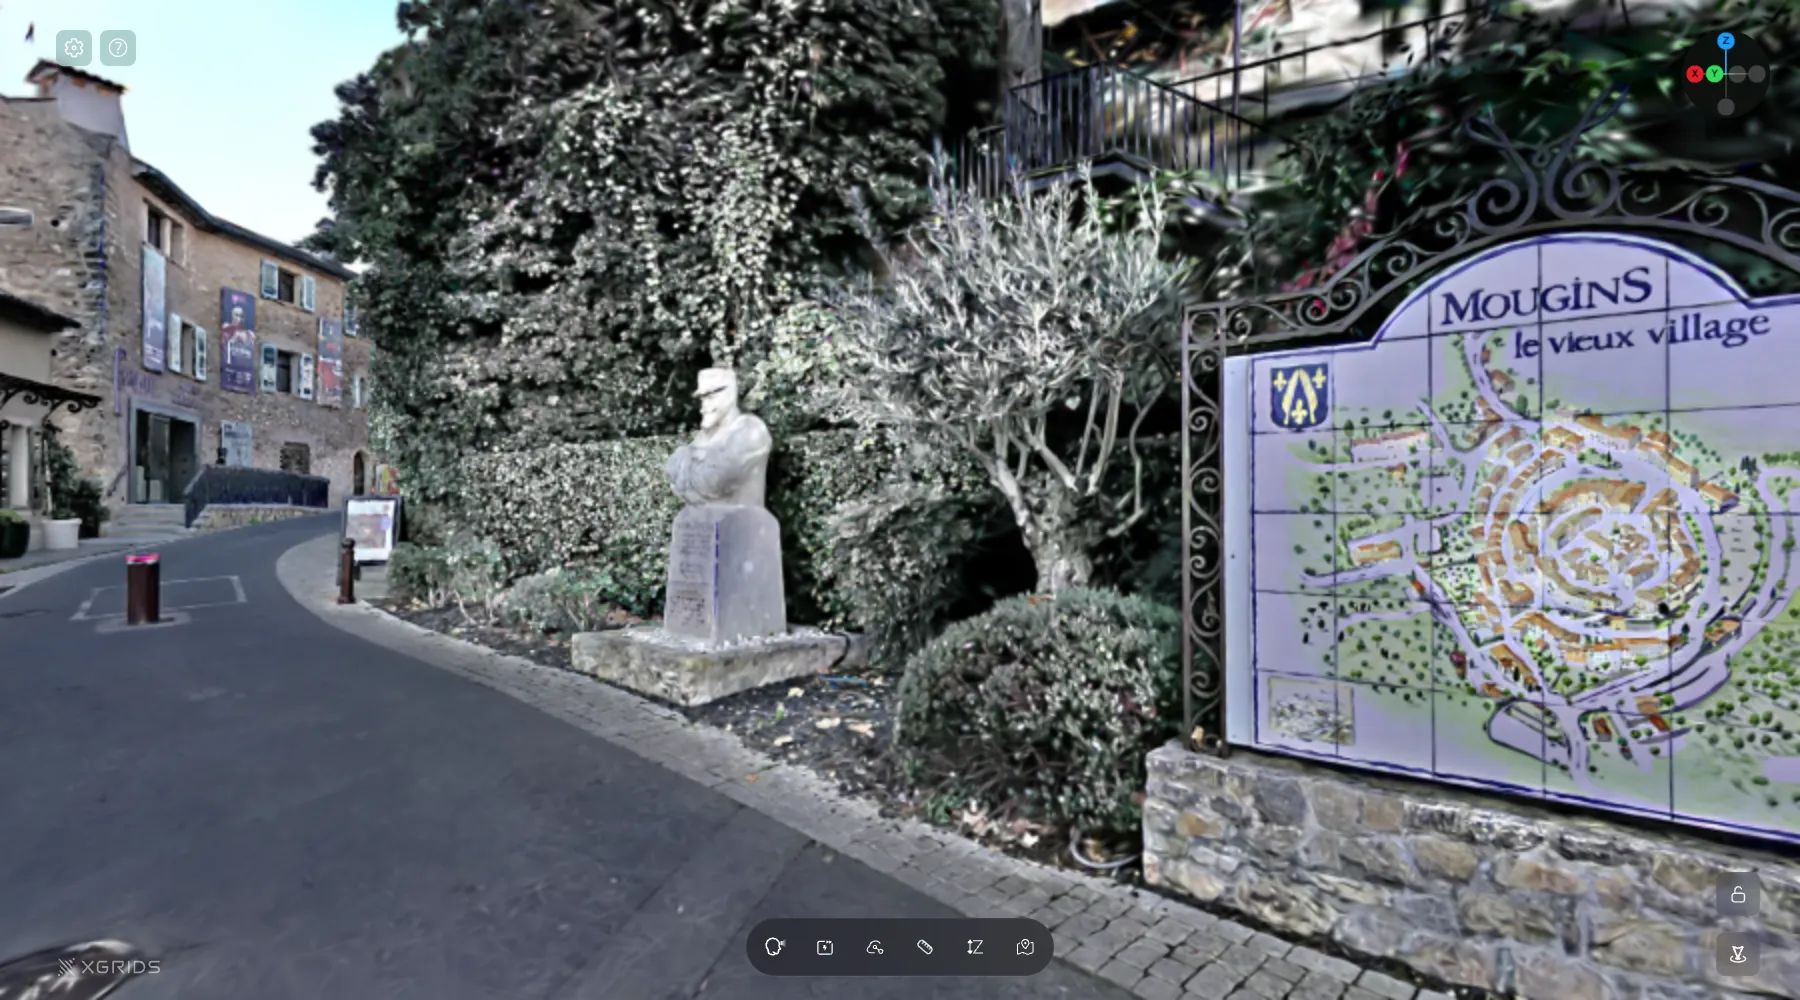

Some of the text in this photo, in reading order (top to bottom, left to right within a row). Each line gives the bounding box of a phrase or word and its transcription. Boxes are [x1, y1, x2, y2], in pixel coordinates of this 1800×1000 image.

[1514, 312, 1772, 359] le vieux village
